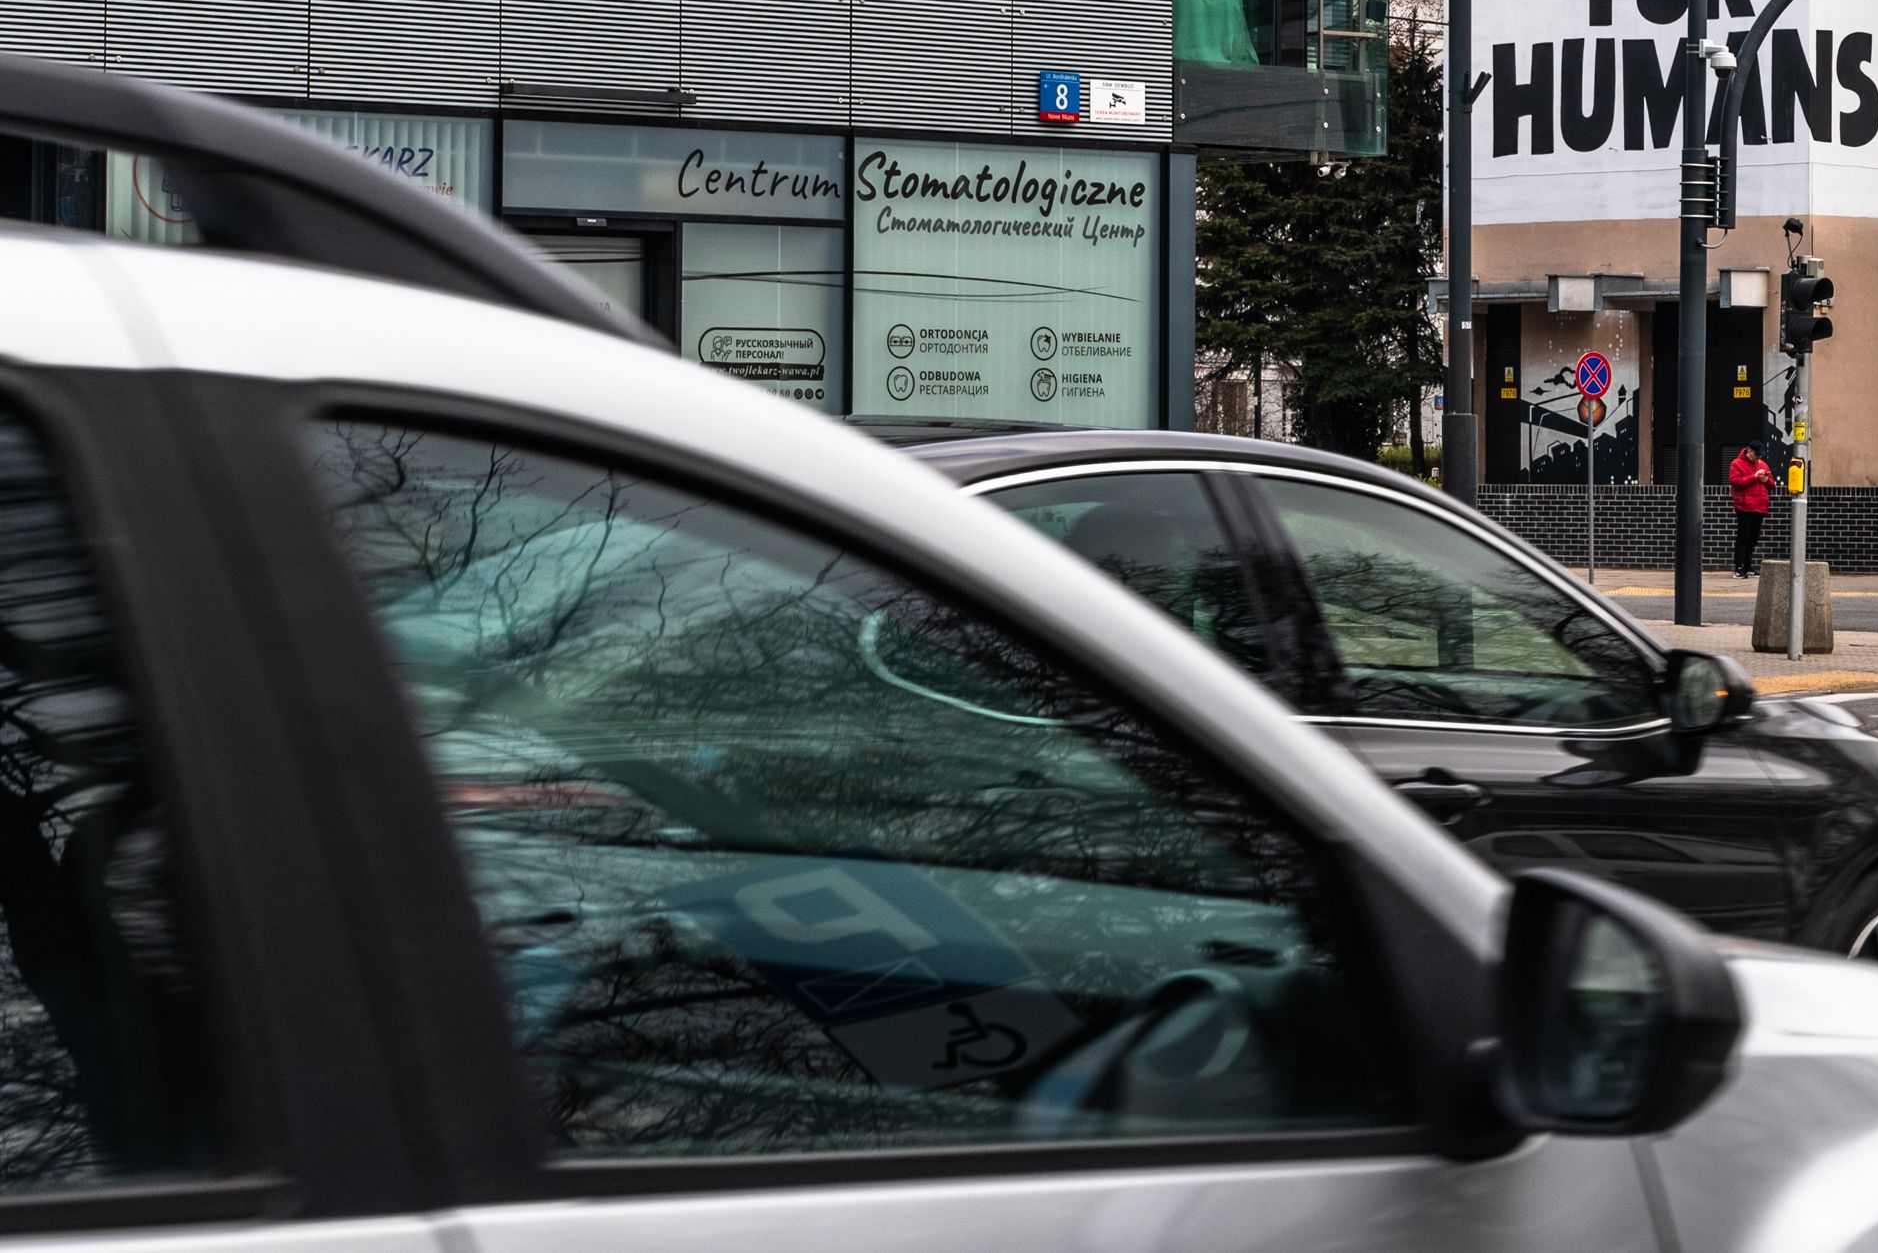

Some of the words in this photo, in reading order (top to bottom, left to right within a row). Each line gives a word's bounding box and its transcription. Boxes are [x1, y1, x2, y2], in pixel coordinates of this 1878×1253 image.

[1056, 83, 1068, 110] 8
[678, 148, 841, 199] Centrum
[856, 150, 1146, 217] Stomatologiczne
[876, 206, 1074, 239] Стоматологический
[1082, 215, 1146, 247] Центр
[919, 329, 989, 341] ORTODONCJA
[1061, 332, 1121, 343] WYBIELANIE
[735, 338, 814, 349] РУССКОЯЗЫЧНЫЙ
[919, 343, 989, 355] ОРТОДОНТИЯ
[735, 350, 785, 360] ПЕРСОНАЛ!
[1061, 346, 1132, 357] ОТБЕЛИВАНИЕ
[919, 370, 981, 382] ODBUDOWA
[1061, 373, 1103, 384] HIGIENA
[919, 384, 989, 397] РЕСТАВРАЦИЯ
[1061, 386, 1106, 397] ГИГИЕНА
[1735, 388, 1750, 397] 7976
